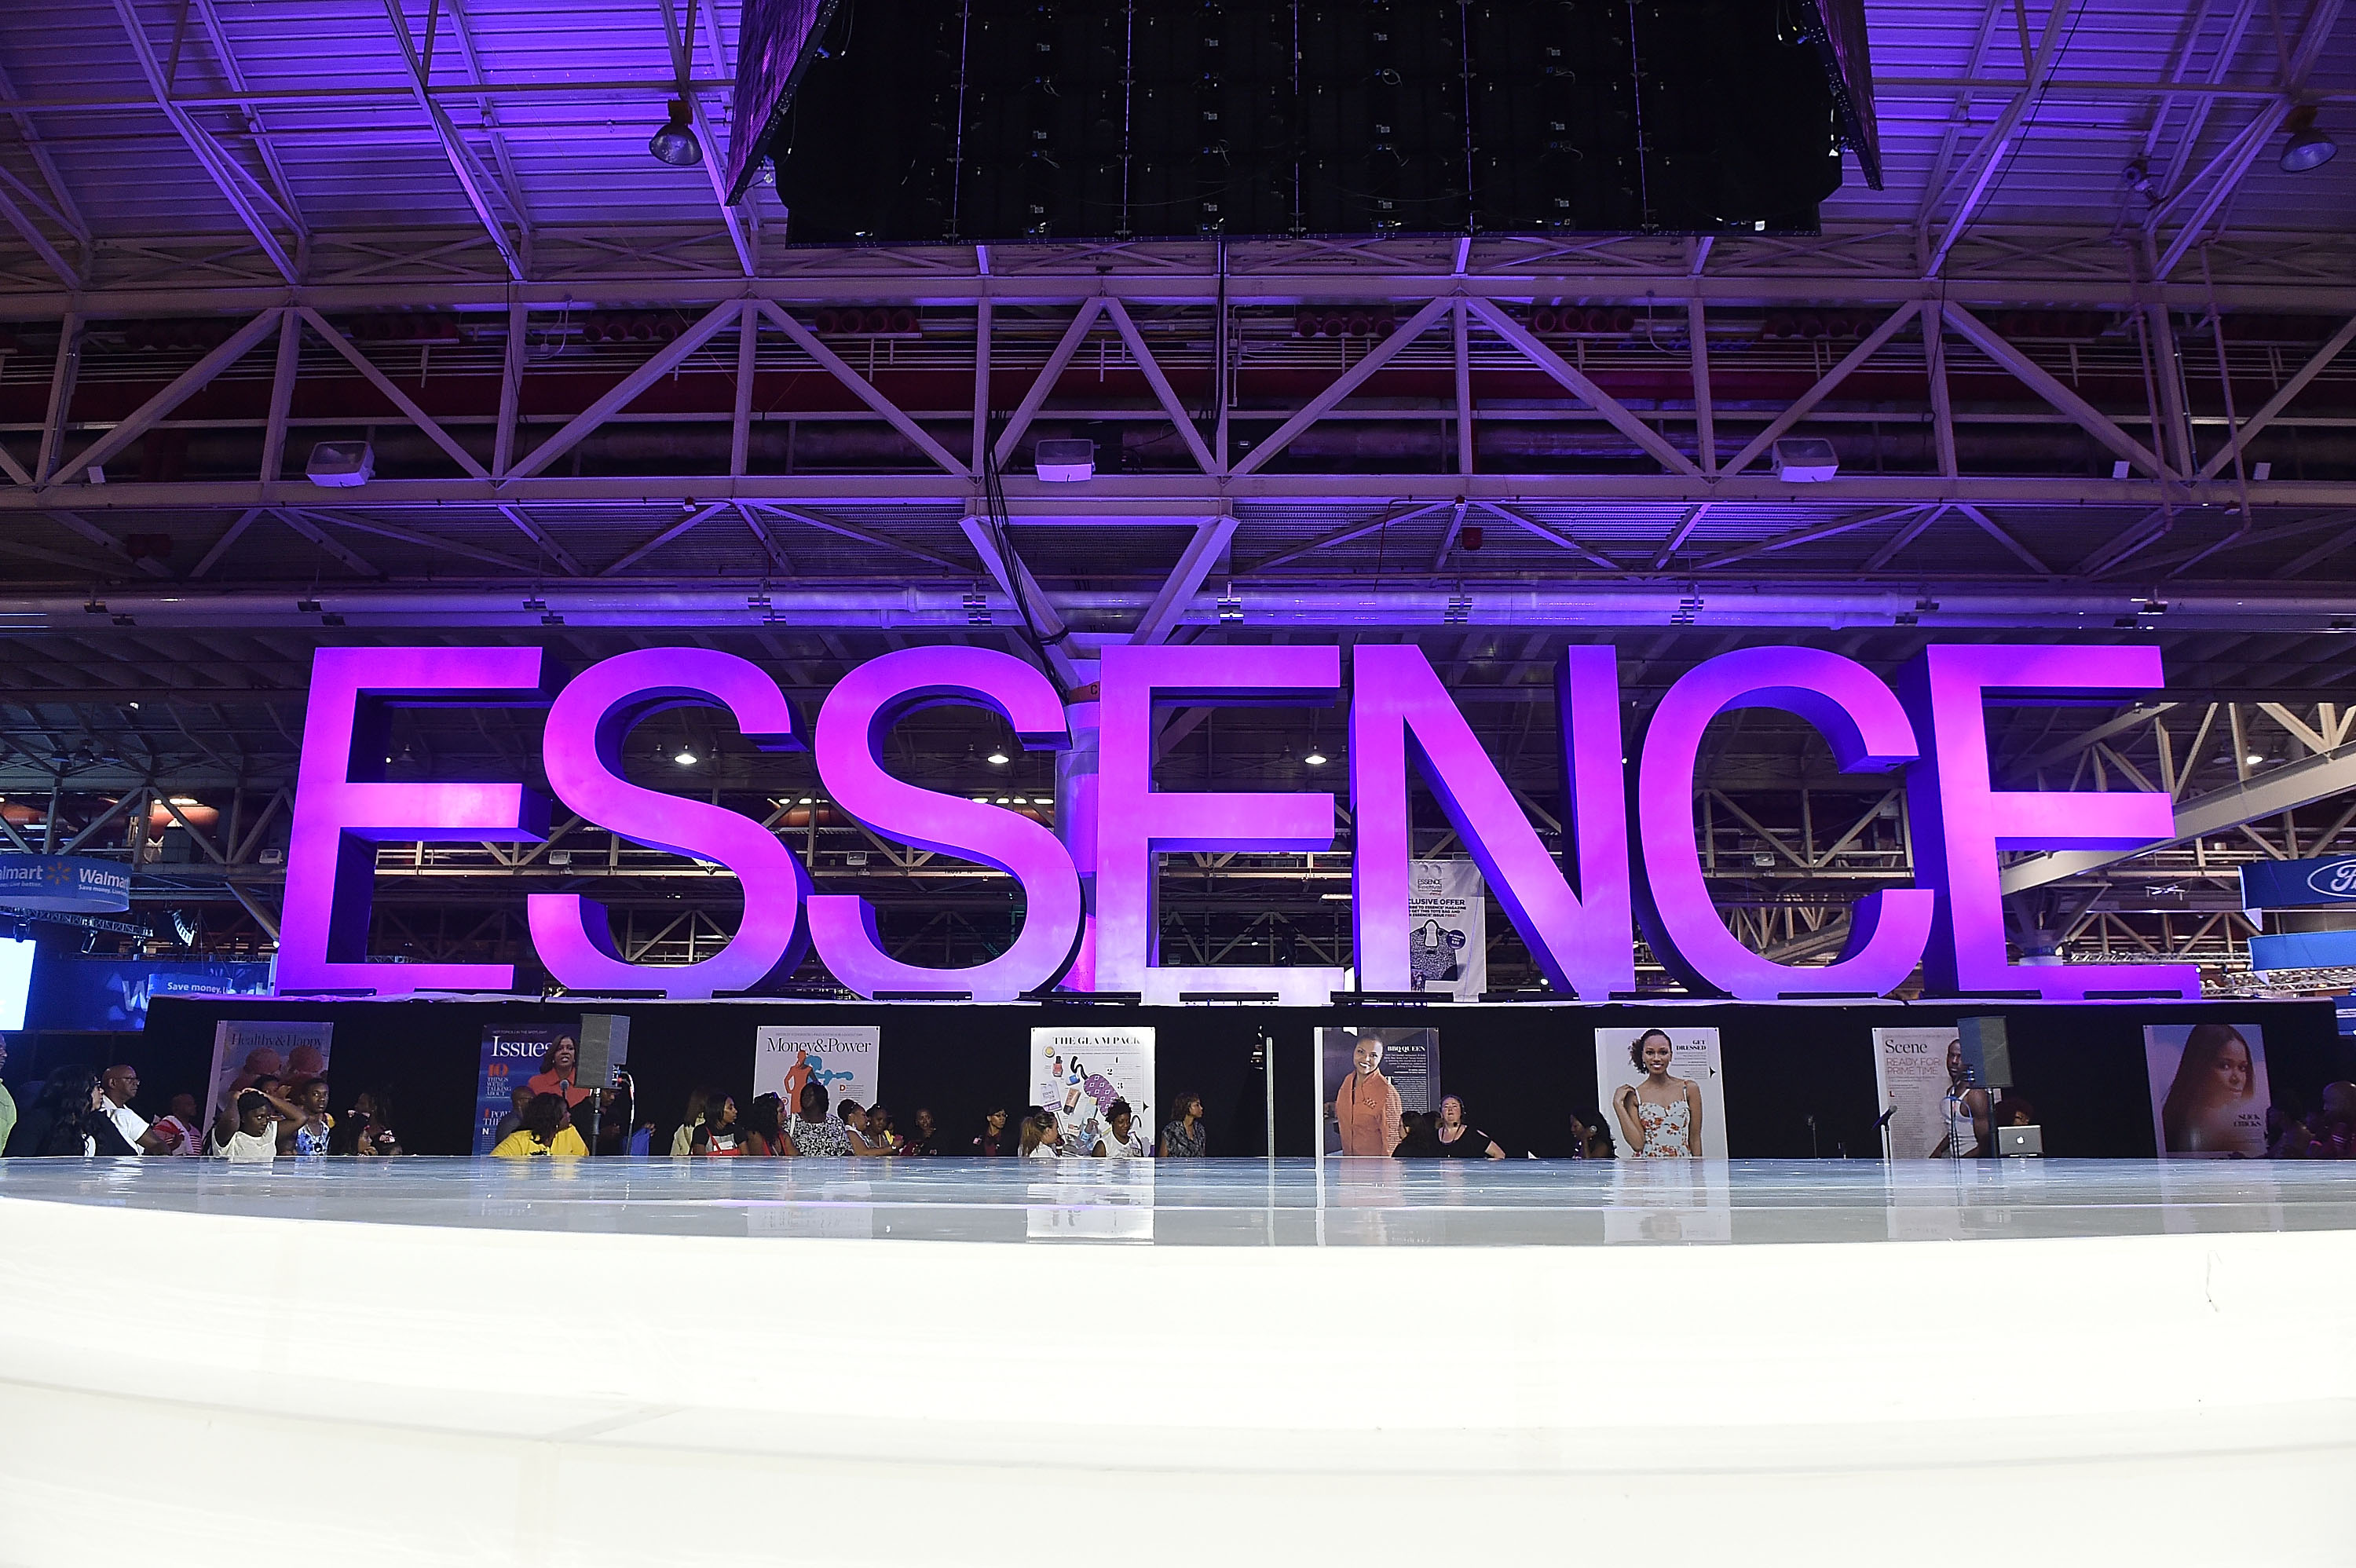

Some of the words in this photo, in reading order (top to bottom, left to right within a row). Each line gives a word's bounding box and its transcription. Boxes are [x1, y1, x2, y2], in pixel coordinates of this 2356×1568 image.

[275, 644, 2200, 1000] ESSENCE
[167, 981, 189, 991] Save
[191, 984, 221, 995] money.
[1113, 1036, 1141, 1045] PACK
[1885, 1039, 1927, 1054] Scene
[1886, 1057, 1917, 1066] READY
[1920, 1057, 1941, 1066] FOR
[1887, 1066, 1915, 1075] PRIME
[1917, 1066, 1938, 1075] TIME
